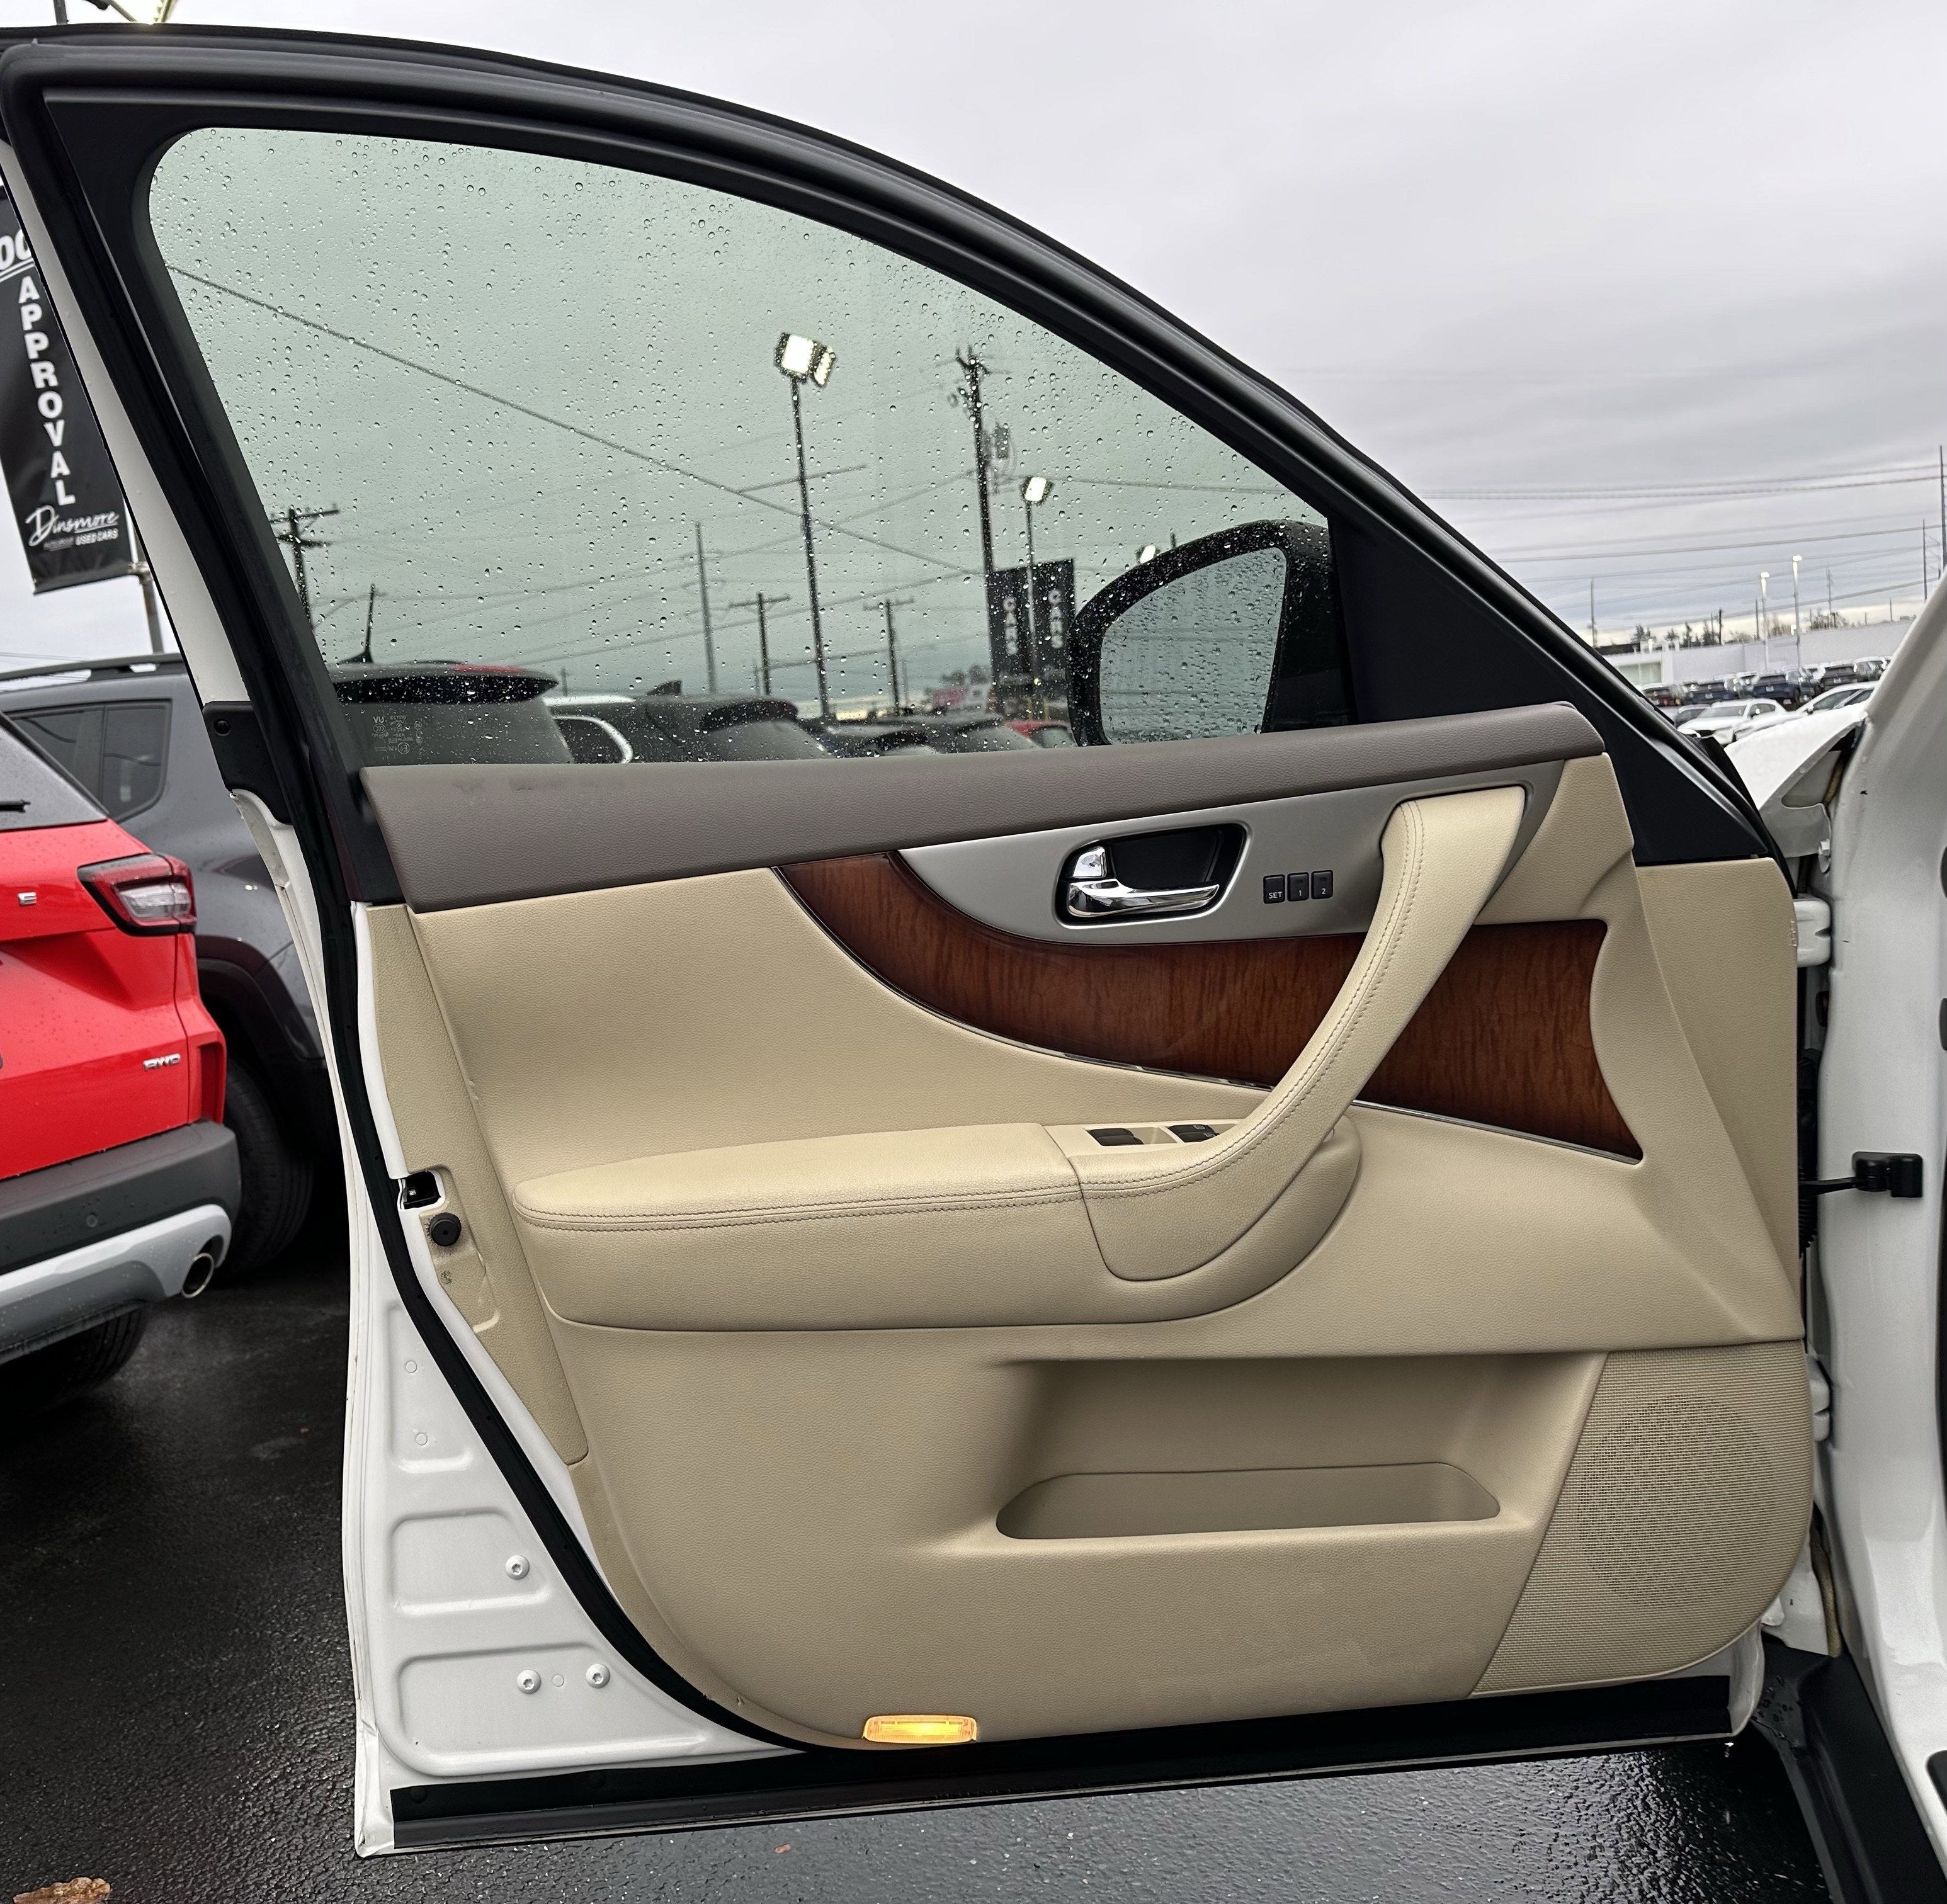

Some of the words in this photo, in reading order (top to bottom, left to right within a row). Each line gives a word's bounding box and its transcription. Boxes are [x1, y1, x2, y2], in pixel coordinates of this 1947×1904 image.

[19, 276, 76, 506] APPROVAL
[25, 505, 119, 547] Dinsmore
[75, 533, 97, 546] USED
[1268, 891, 1283, 899] SET
